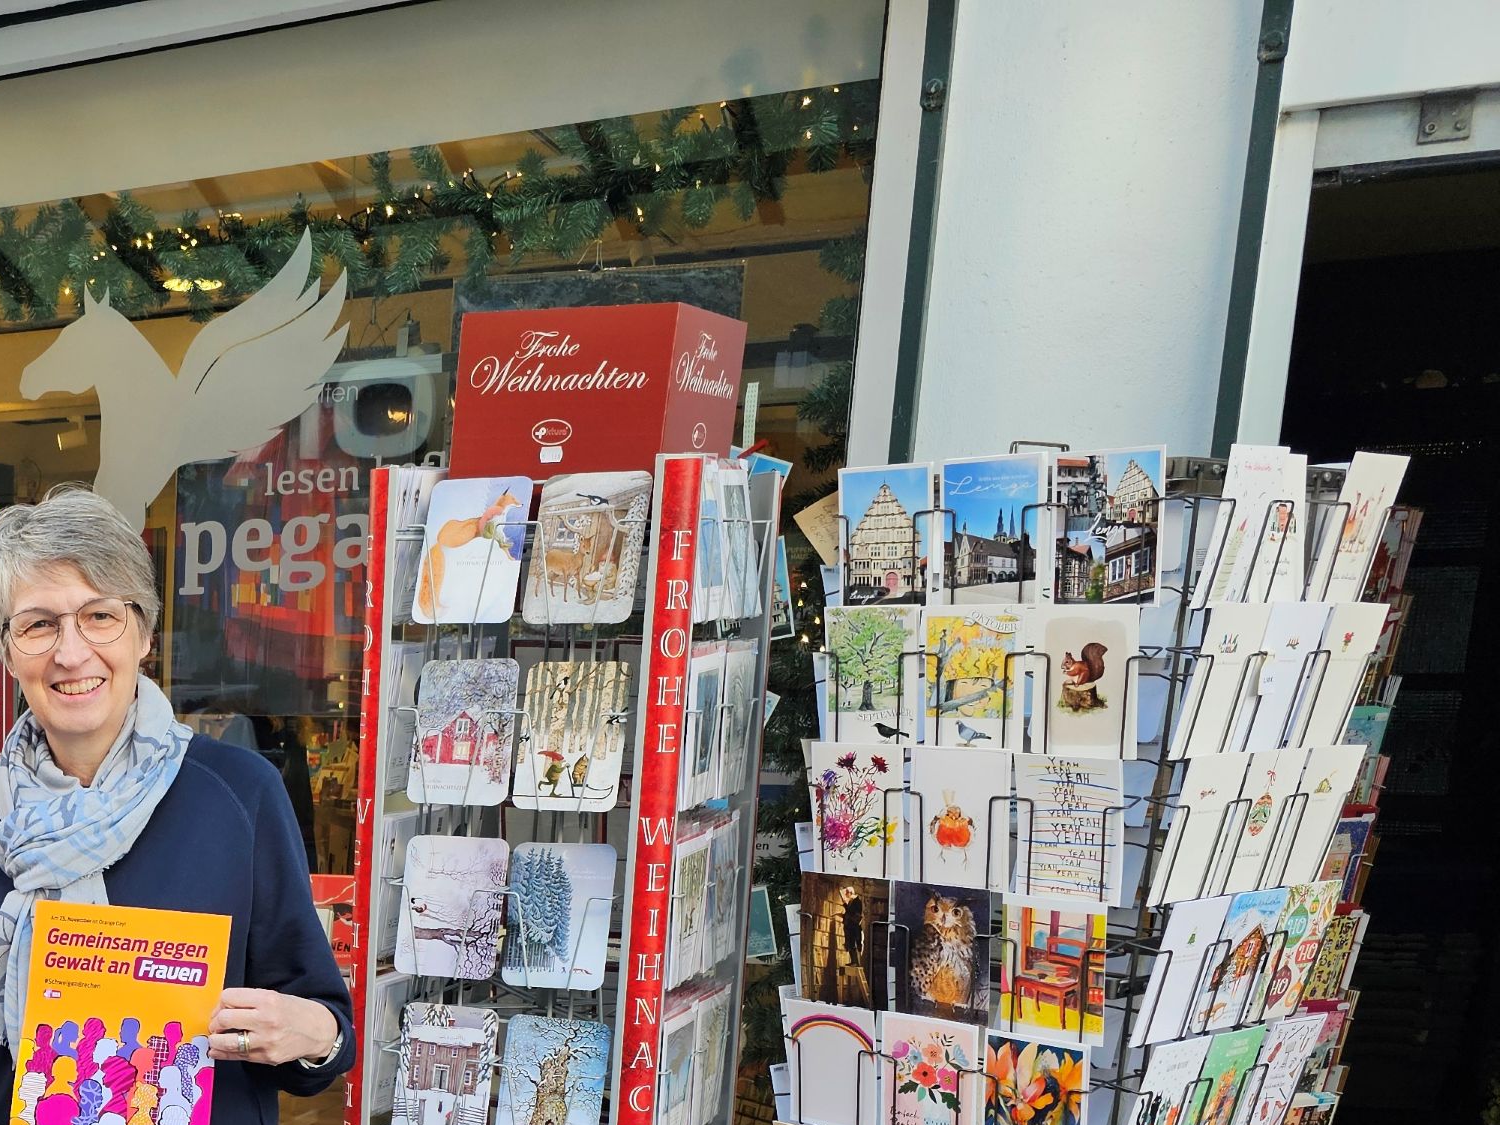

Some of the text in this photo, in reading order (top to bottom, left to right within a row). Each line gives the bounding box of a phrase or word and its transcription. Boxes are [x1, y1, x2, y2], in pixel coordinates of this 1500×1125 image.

[515, 330, 580, 359] Frohe
[695, 331, 718, 362] Frohe
[470, 355, 649, 395] Weihnachten
[676, 351, 734, 400] Weihnachten
[264, 462, 360, 496] lesen
[946, 476, 1038, 497] Lemgo
[1081, 512, 1125, 543] Lemgo
[179, 513, 370, 596] pega
[849, 591, 876, 604] Lemgo
[971, 610, 1019, 632] OKTOBER
[656, 530, 692, 753] FROHE
[1048, 756, 1078, 767] YEAH
[1059, 773, 1090, 784] YEAH
[1060, 801, 1088, 810] YEAH
[1051, 823, 1080, 832] YEAH
[1073, 818, 1100, 828] YEAH
[1052, 830, 1095, 845] YEAH
[1287, 917, 1306, 935] HO
[48, 928, 208, 959] Gemeinsam gegen
[1297, 942, 1318, 961] HO
[45, 952, 202, 983] Gewalt an Frauen
[1270, 978, 1288, 996] HO
